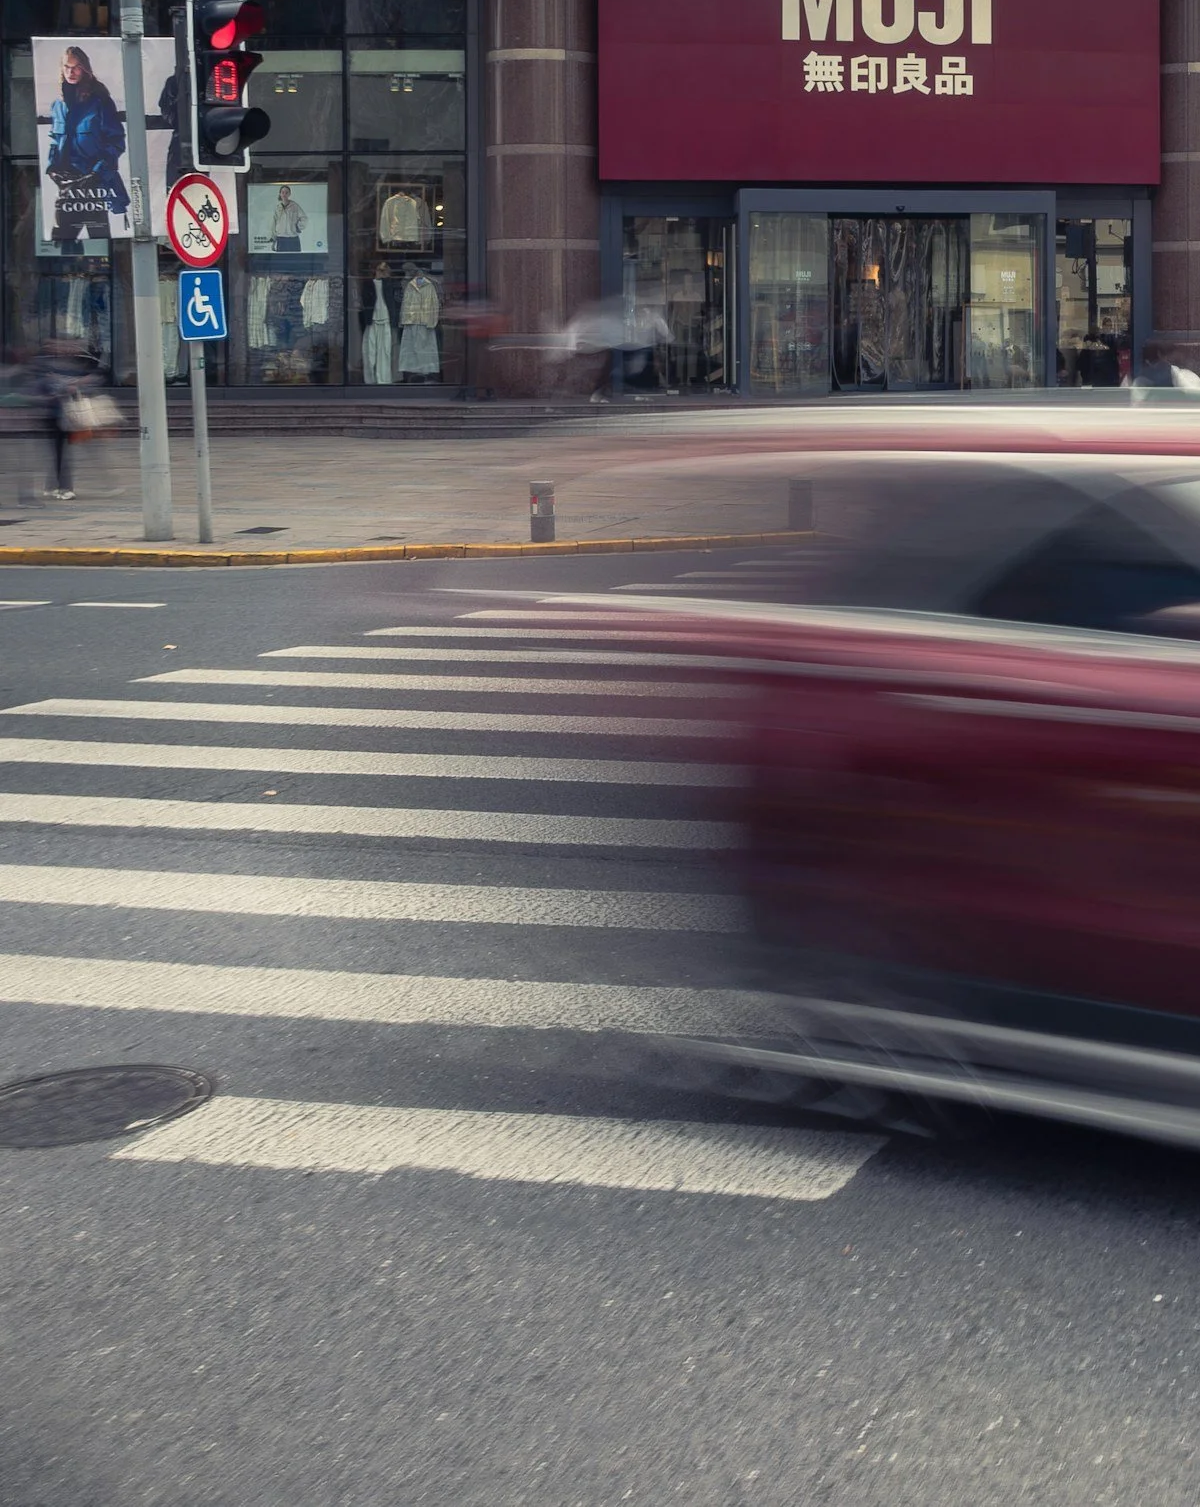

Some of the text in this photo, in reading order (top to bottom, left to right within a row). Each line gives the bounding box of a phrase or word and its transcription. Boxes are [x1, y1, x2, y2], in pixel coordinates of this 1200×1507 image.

[802, 50, 974, 96] 無印良品
[62, 201, 113, 212] GOOSE
